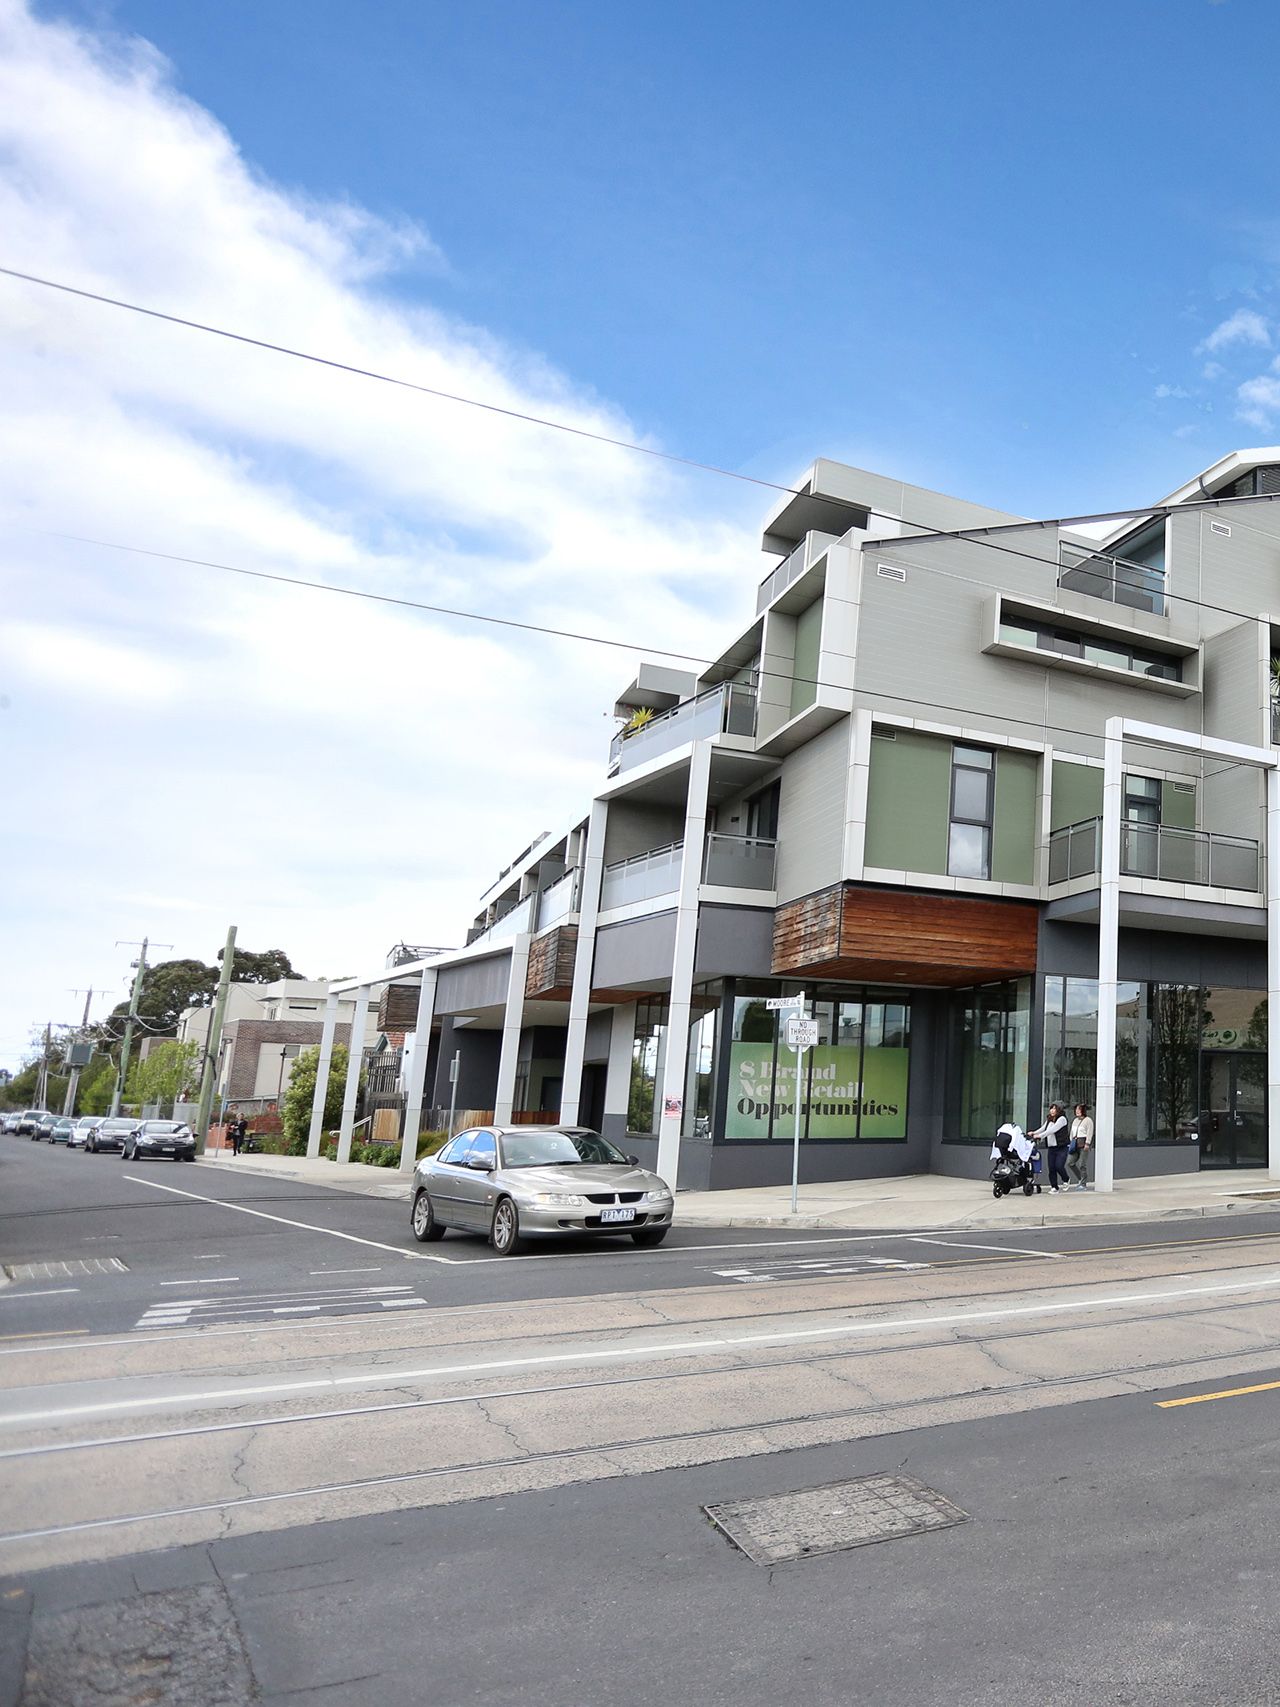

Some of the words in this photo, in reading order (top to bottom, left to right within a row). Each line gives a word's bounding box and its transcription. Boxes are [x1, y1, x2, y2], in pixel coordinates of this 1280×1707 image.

[773, 999, 790, 1007] MOORE
[800, 1021, 807, 1029] NO
[791, 1028, 816, 1036] THROUGH
[795, 1035, 810, 1043] ROAD
[740, 1060, 755, 1079] 8
[760, 1061, 836, 1080] Brand
[738, 1080, 790, 1097] New
[803, 1081, 864, 1098] Retail
[738, 1097, 898, 1119] Opportunities
